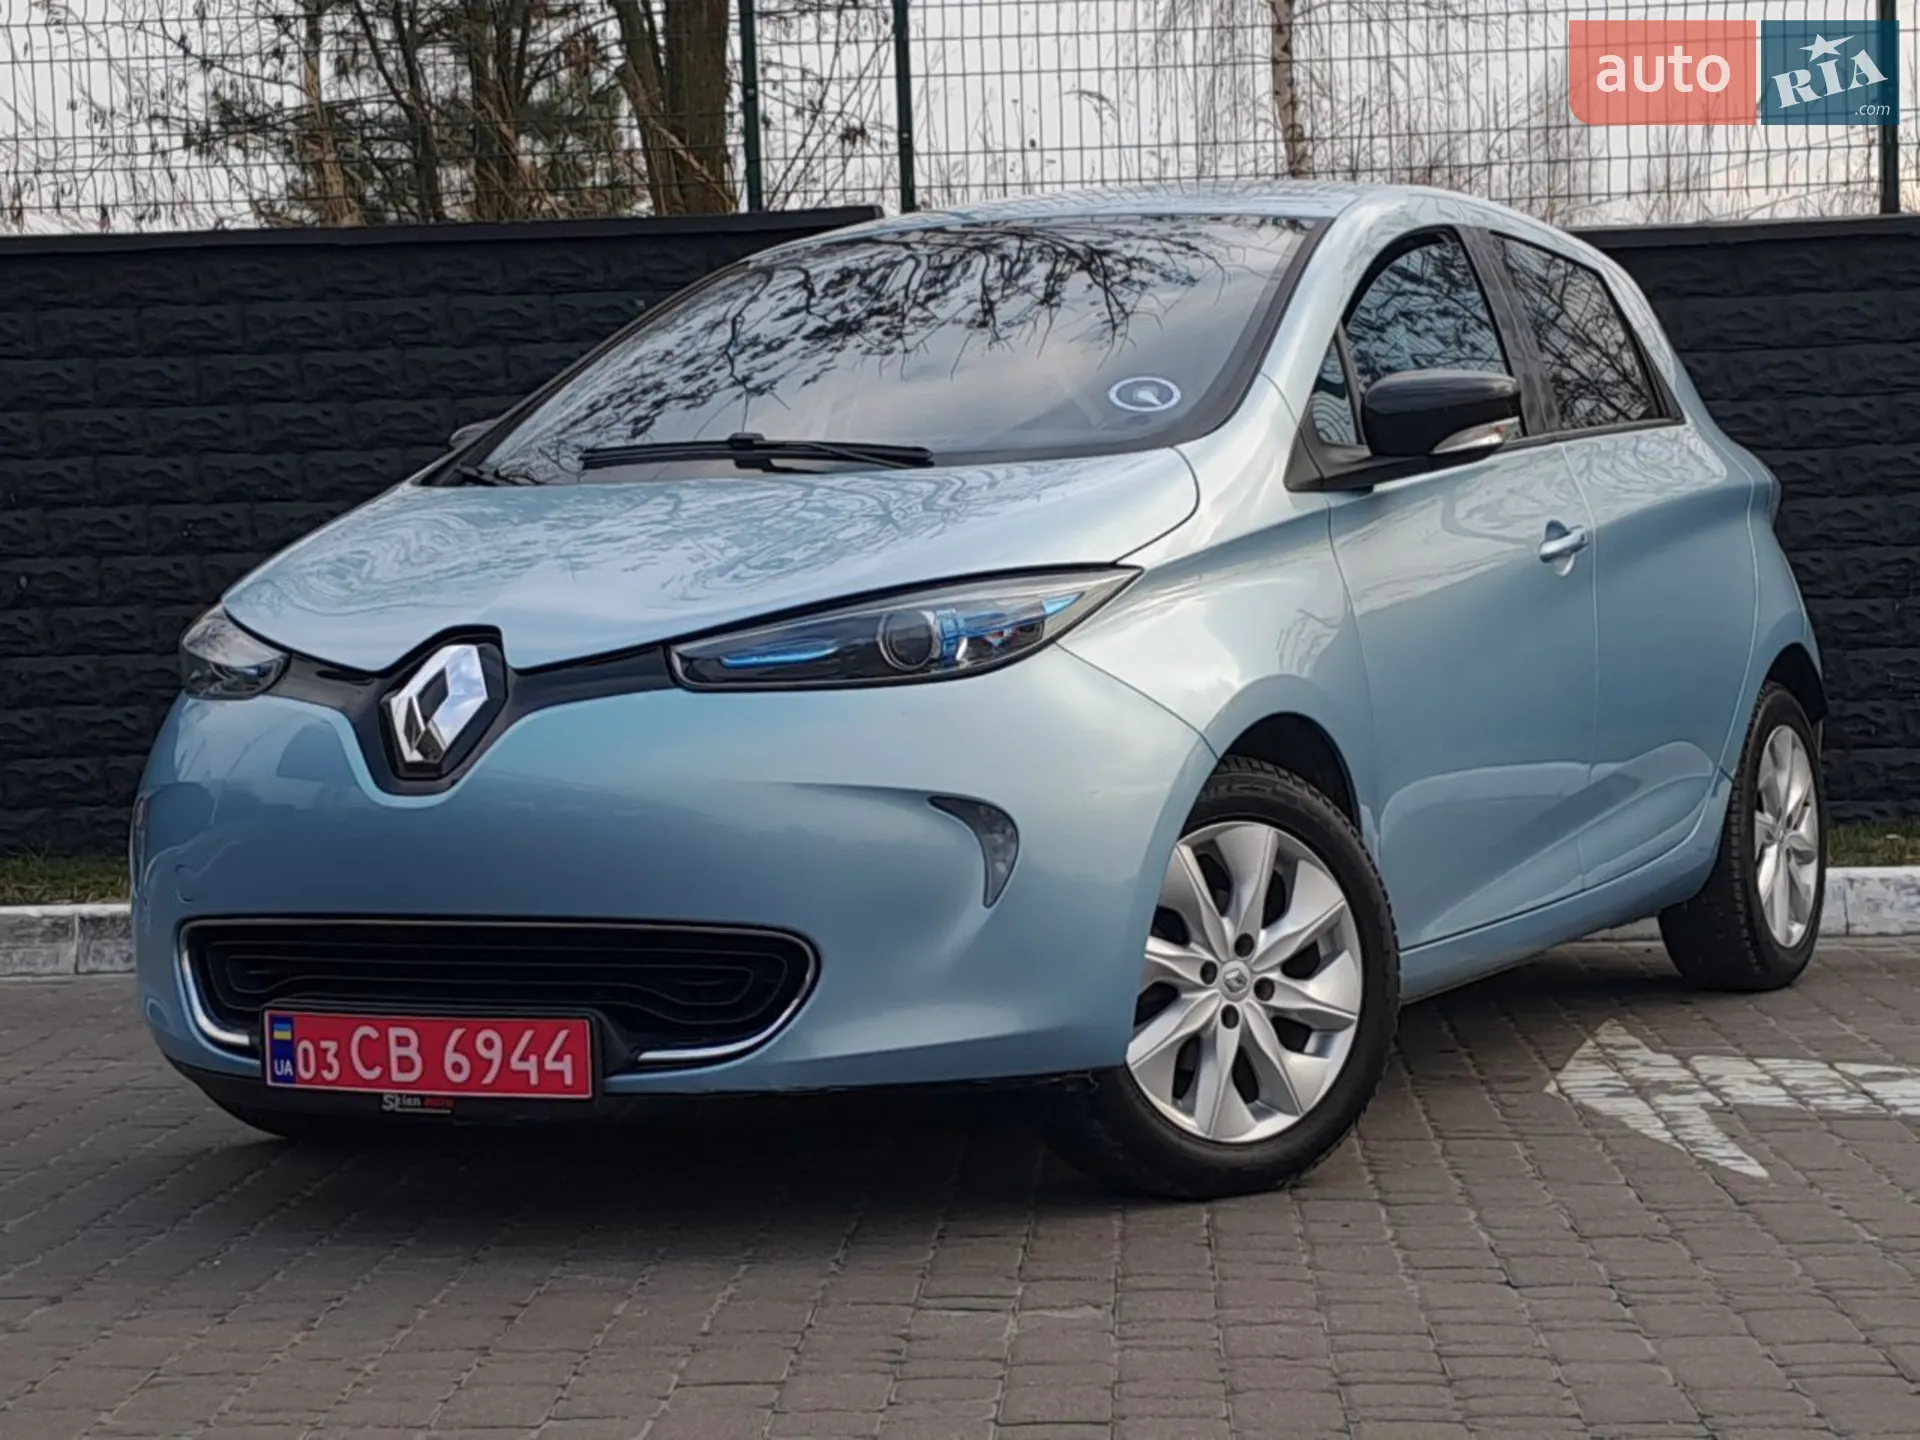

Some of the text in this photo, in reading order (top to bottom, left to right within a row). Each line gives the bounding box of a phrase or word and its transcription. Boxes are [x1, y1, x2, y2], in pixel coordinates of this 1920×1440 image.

[274, 1059, 294, 1076] UA
[297, 1026, 574, 1086] 03 CB 6944
